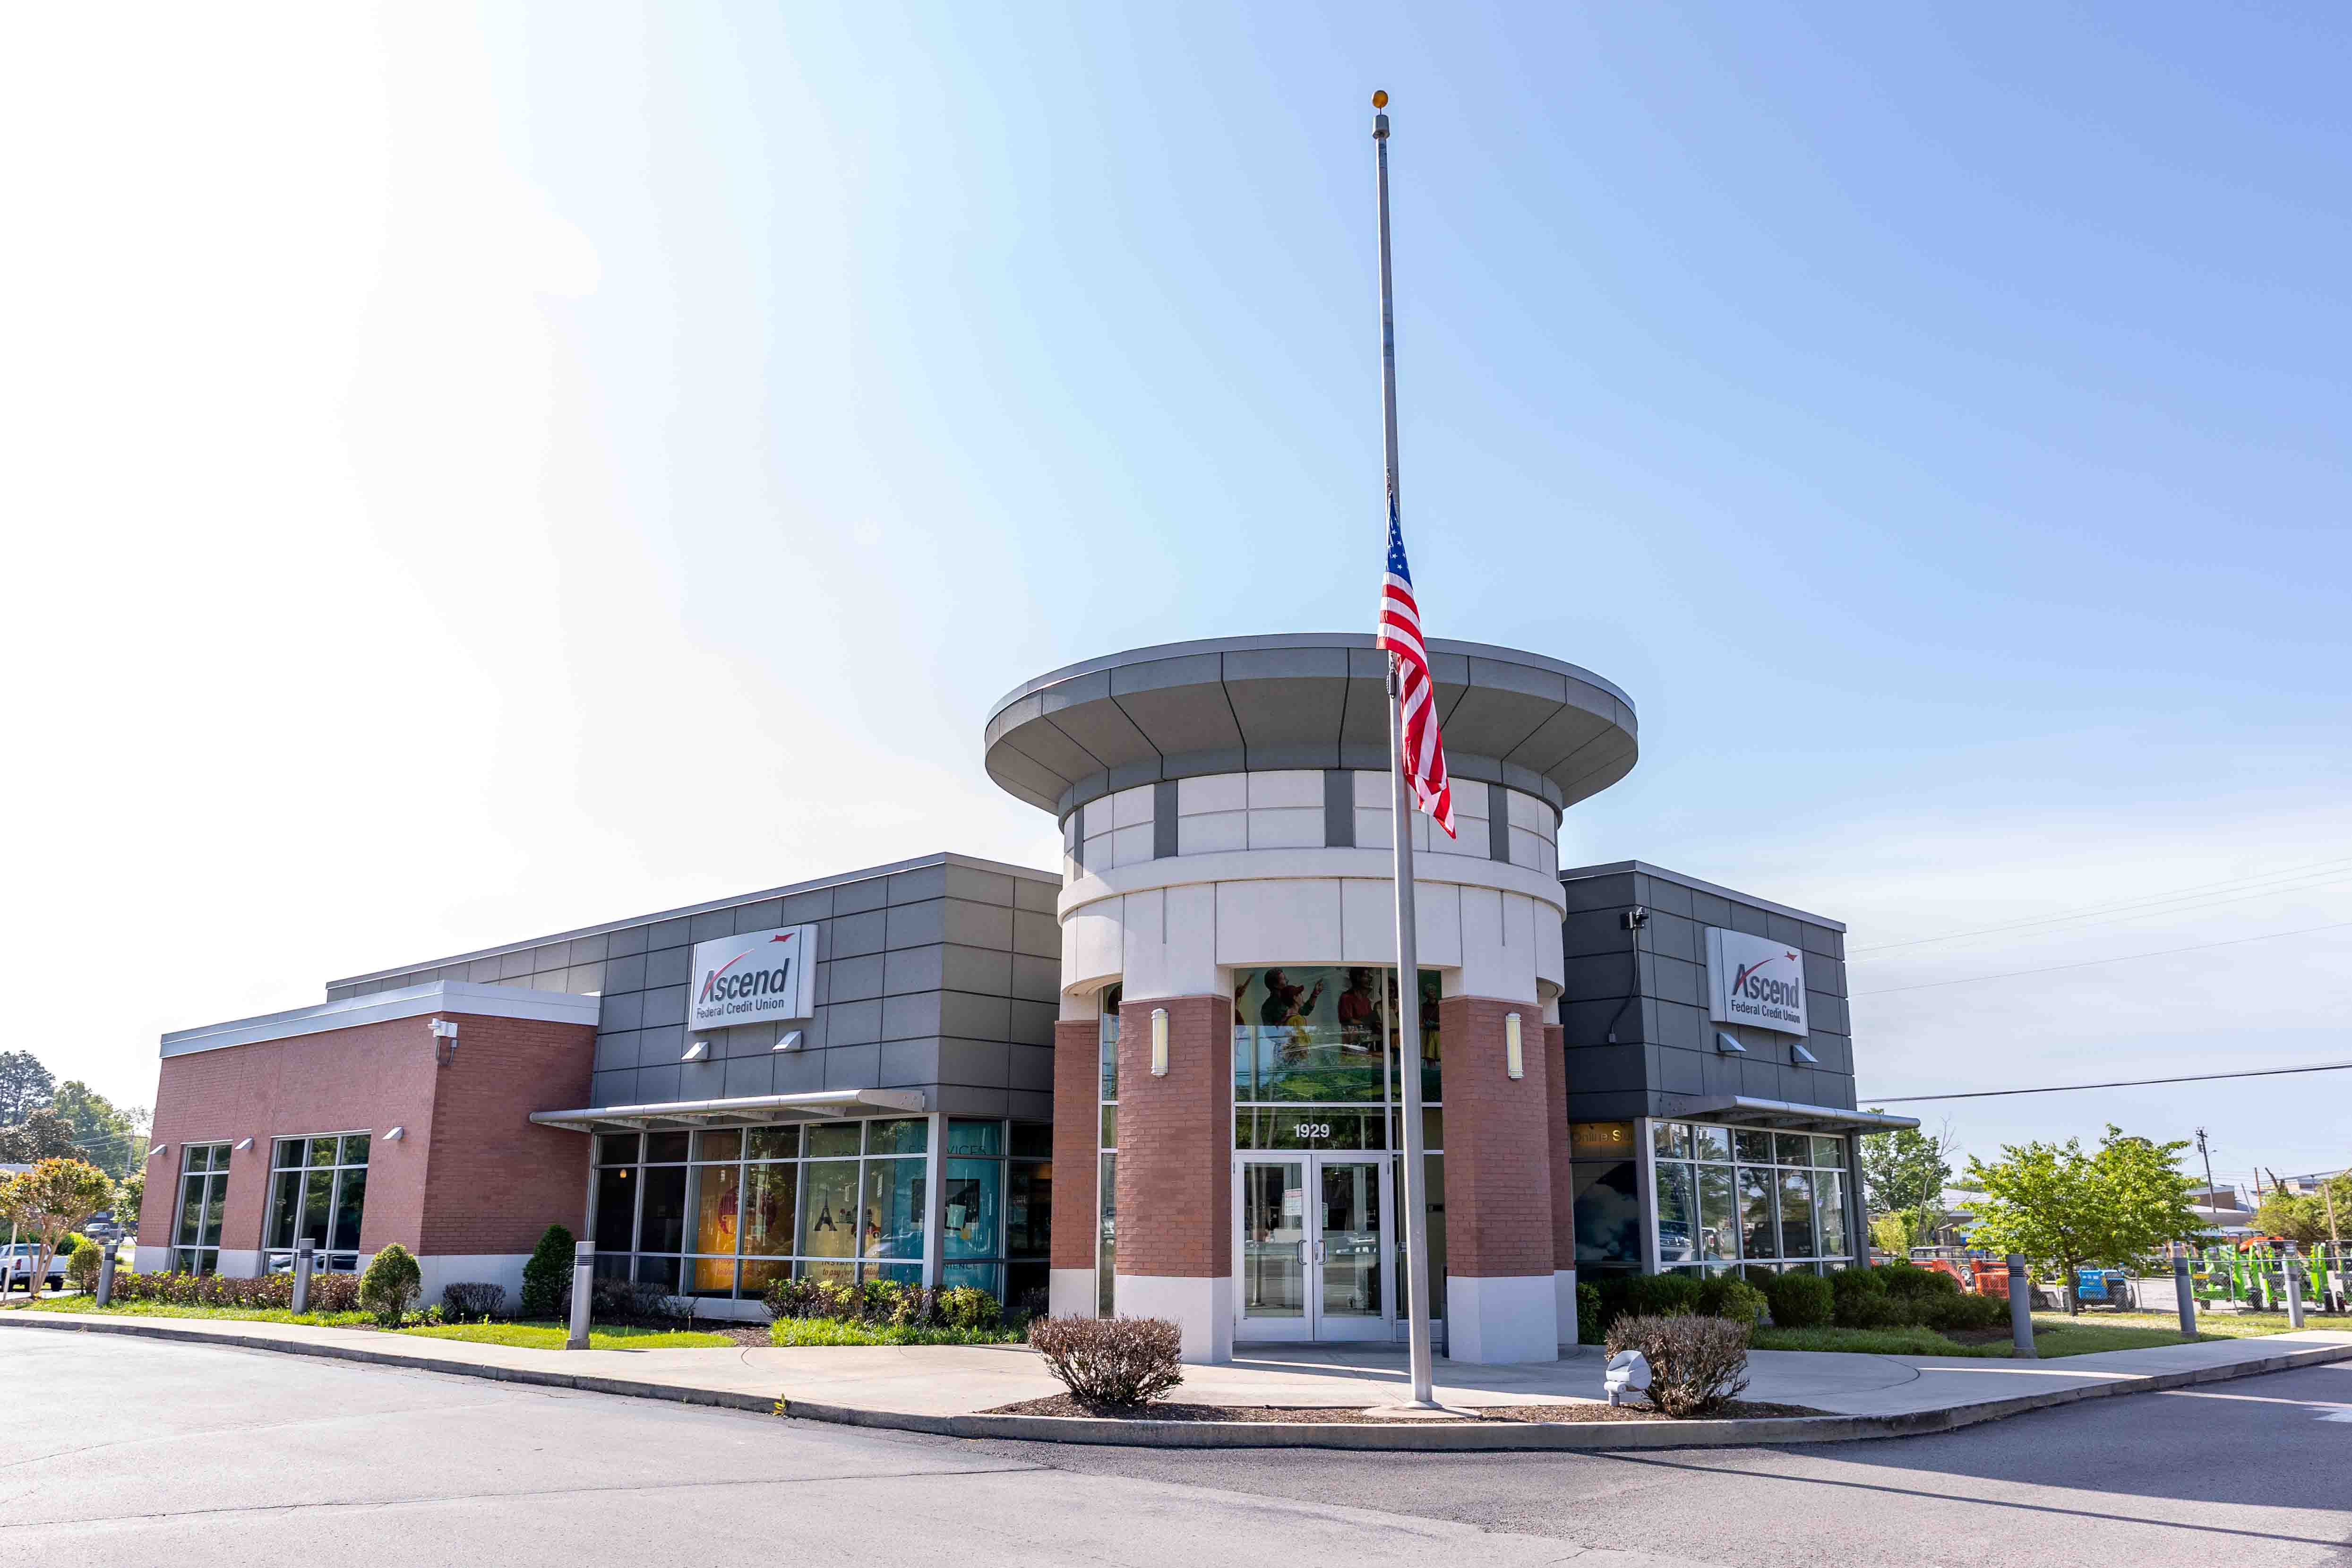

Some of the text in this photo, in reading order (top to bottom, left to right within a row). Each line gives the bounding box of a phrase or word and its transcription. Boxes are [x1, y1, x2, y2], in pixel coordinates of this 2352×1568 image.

[698, 956, 790, 1004] Ascend
[1732, 963, 1799, 1009] Ascend
[696, 997, 784, 1019] Federal Credit Union
[1731, 999, 1800, 1024] Federal Credit Union
[1293, 1123, 1330, 1138] 1929
